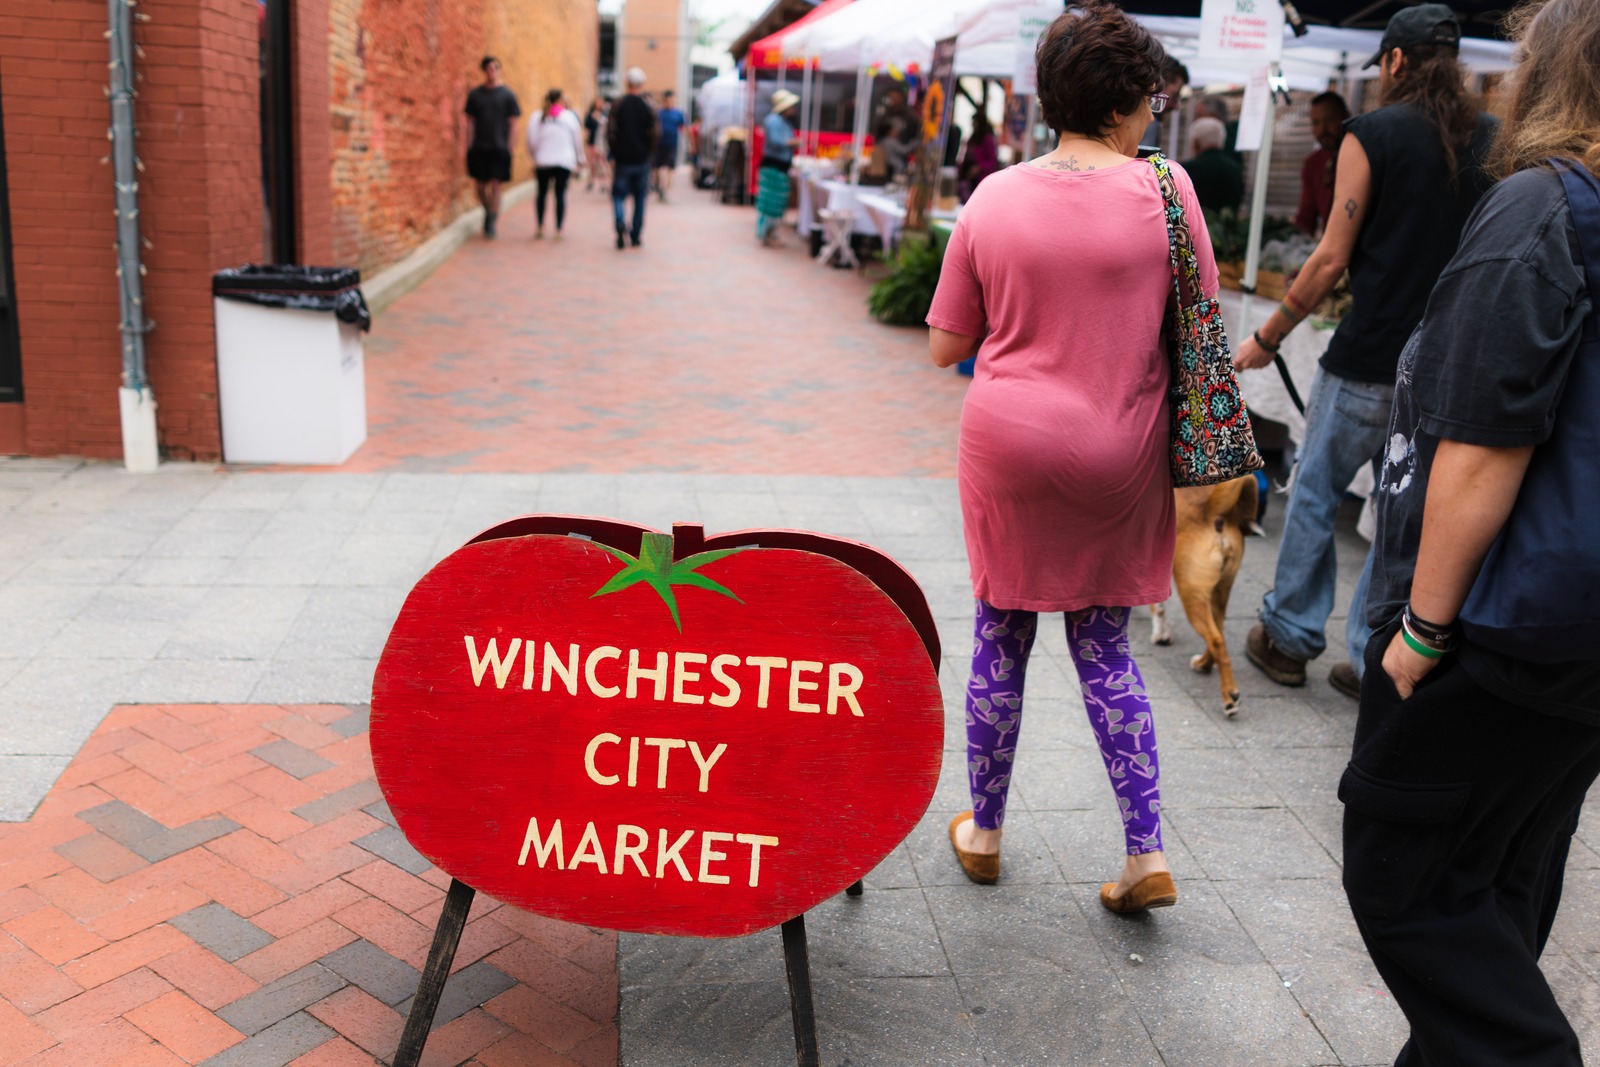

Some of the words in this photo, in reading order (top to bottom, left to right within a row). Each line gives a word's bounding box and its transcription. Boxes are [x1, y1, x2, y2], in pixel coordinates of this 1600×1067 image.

[464, 635, 864, 717] WINCHESTER
[584, 732, 728, 793] CITY
[517, 816, 779, 888] MARKET
